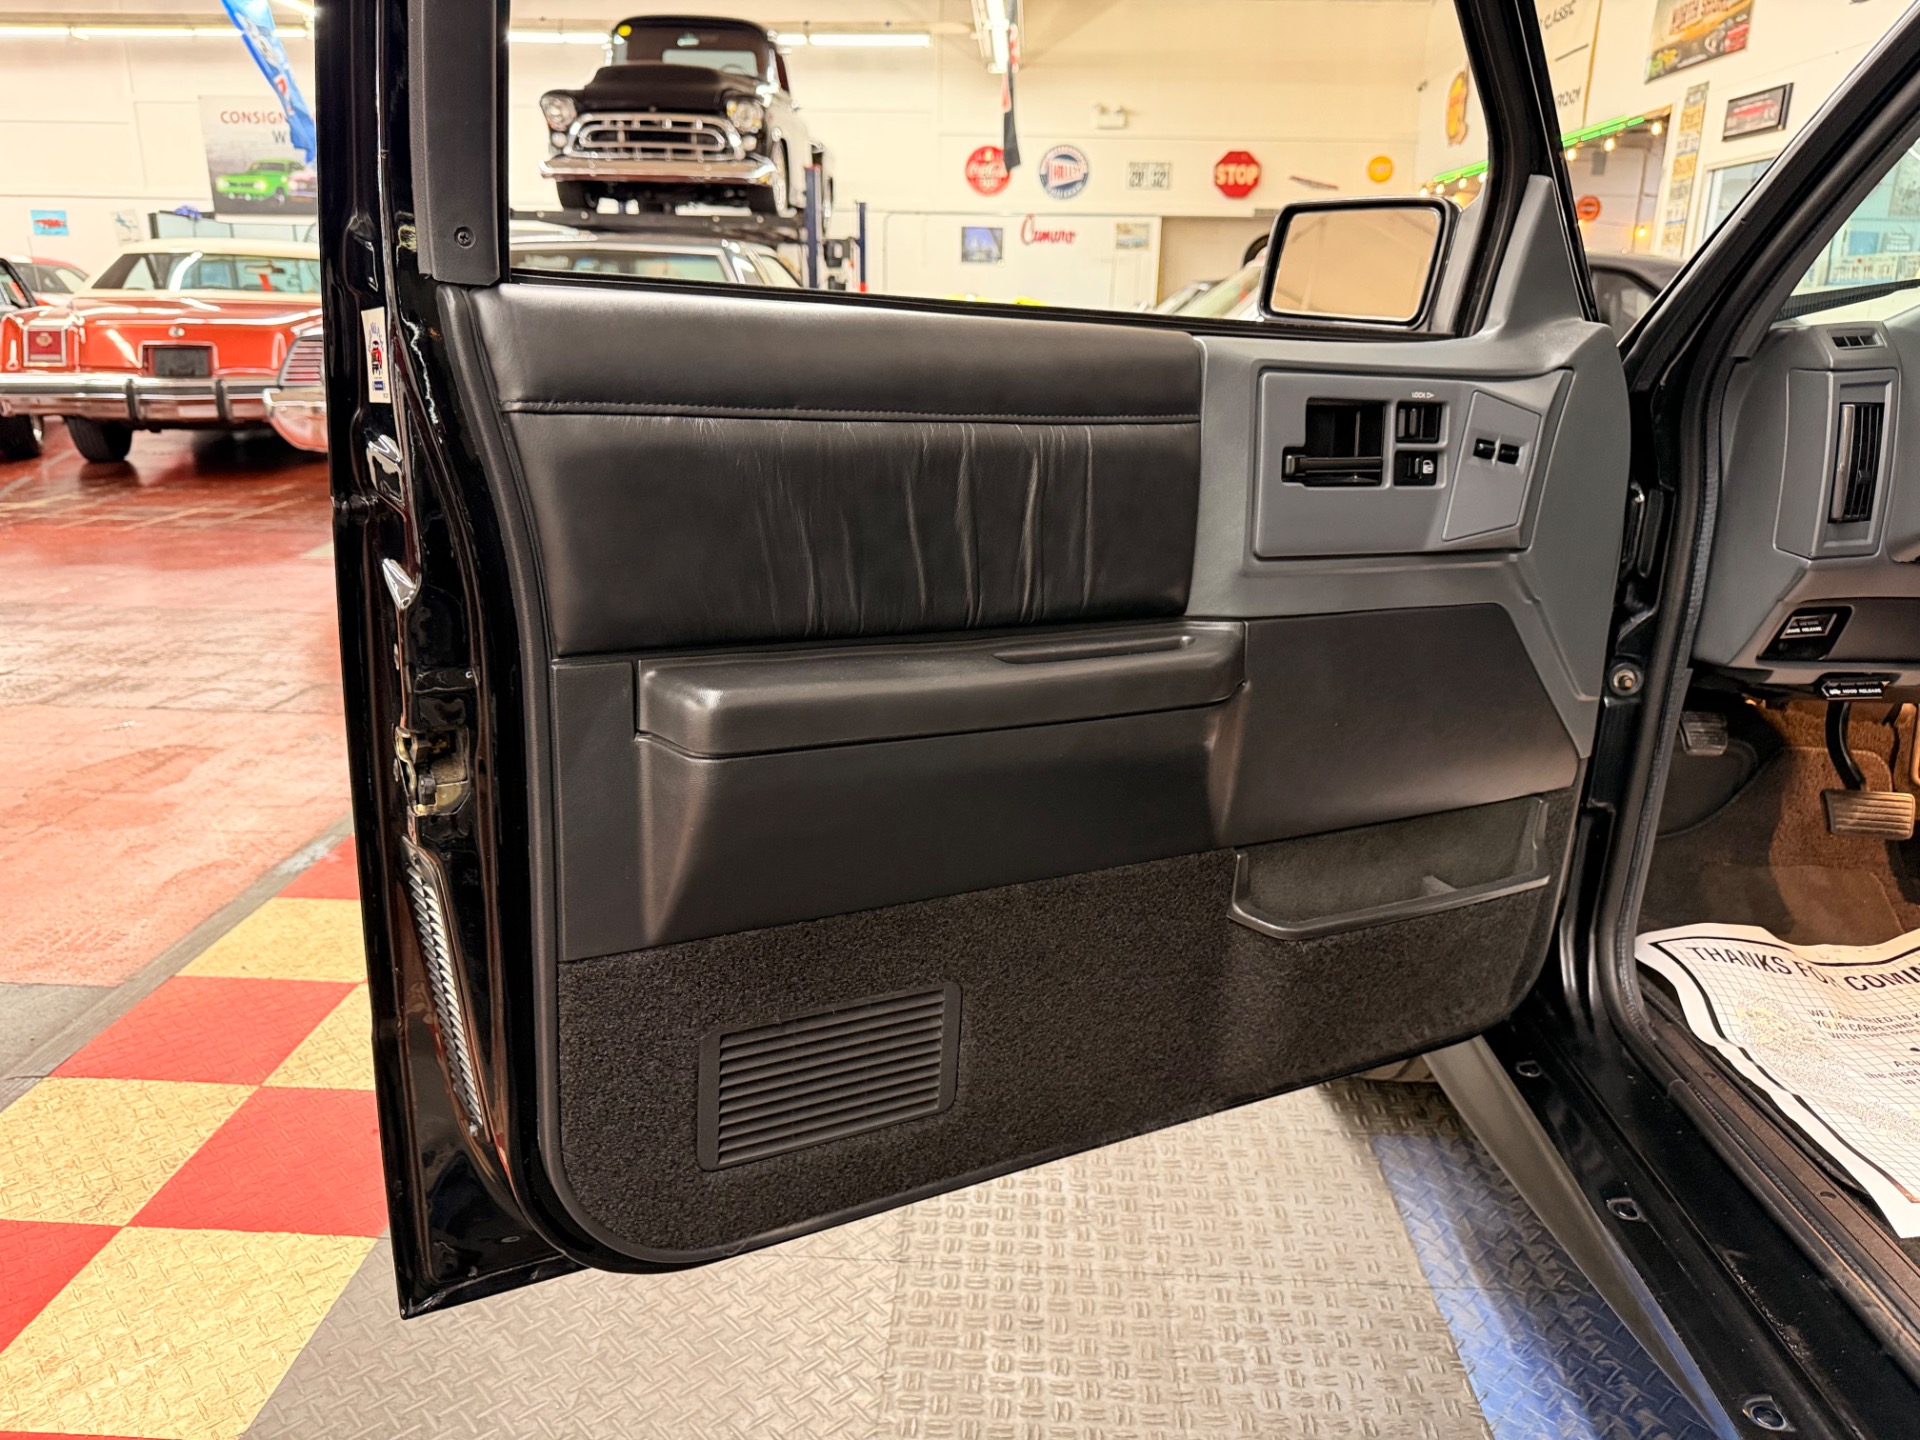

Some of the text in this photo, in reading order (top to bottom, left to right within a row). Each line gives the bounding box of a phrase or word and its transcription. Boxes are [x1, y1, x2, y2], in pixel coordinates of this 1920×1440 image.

[220, 110, 286, 125] CONSIGN
[1215, 163, 1259, 186] STOP
[1021, 213, 1077, 245] Camaro
[1411, 391, 1426, 399] LOCK
[1685, 946, 1793, 975] THANKS
[1807, 1009, 1828, 1018] WE
